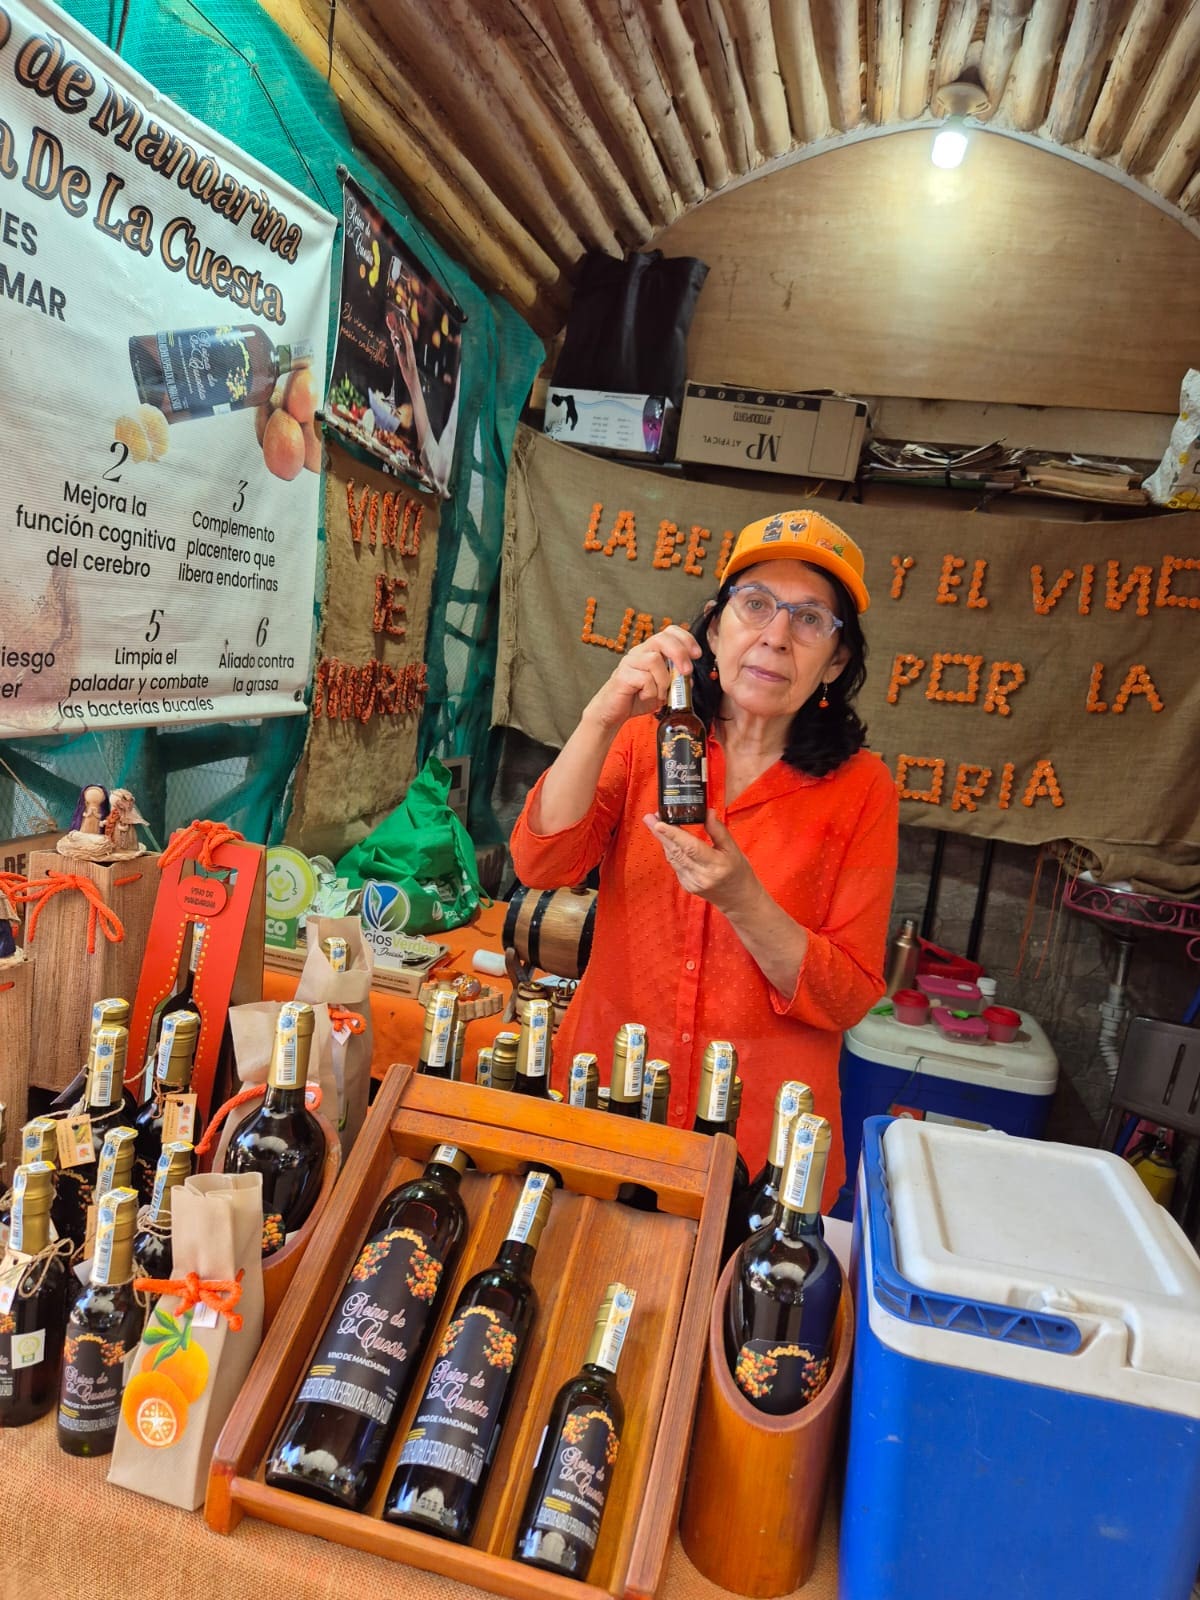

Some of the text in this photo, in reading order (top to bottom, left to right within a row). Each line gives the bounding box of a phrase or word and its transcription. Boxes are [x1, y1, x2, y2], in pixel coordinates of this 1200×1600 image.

[15, 32, 95, 114] de
[89, 79, 303, 264] Mandarina
[0, 208, 38, 256] ES
[22, 126, 91, 217] De
[93, 172, 153, 257] La
[160, 217, 286, 325] Cuesta
[102, 441, 129, 483] 2
[63, 480, 148, 517] Mejora la
[232, 480, 248, 512] 3
[16, 504, 176, 552] función cognitiva
[192, 510, 275, 543] Complemento
[46, 546, 151, 578] del cerebro
[186, 538, 276, 571] placentero que
[583, 502, 638, 561] LA
[891, 554, 915, 600] Y
[936, 554, 989, 608] EL
[178, 562, 279, 592] libera endorfinas
[145, 609, 164, 642] 5
[256, 616, 269, 648] 6
[114, 647, 177, 670] Limpia el
[218, 652, 295, 669] Aliado contra
[68, 672, 209, 697] paladar y combate
[232, 677, 279, 696] la grasa
[887, 653, 1026, 716] POR
[1087, 661, 1164, 713] LA
[58, 695, 214, 719] las bacterias bucales
[895, 754, 1064, 812] ORIA
